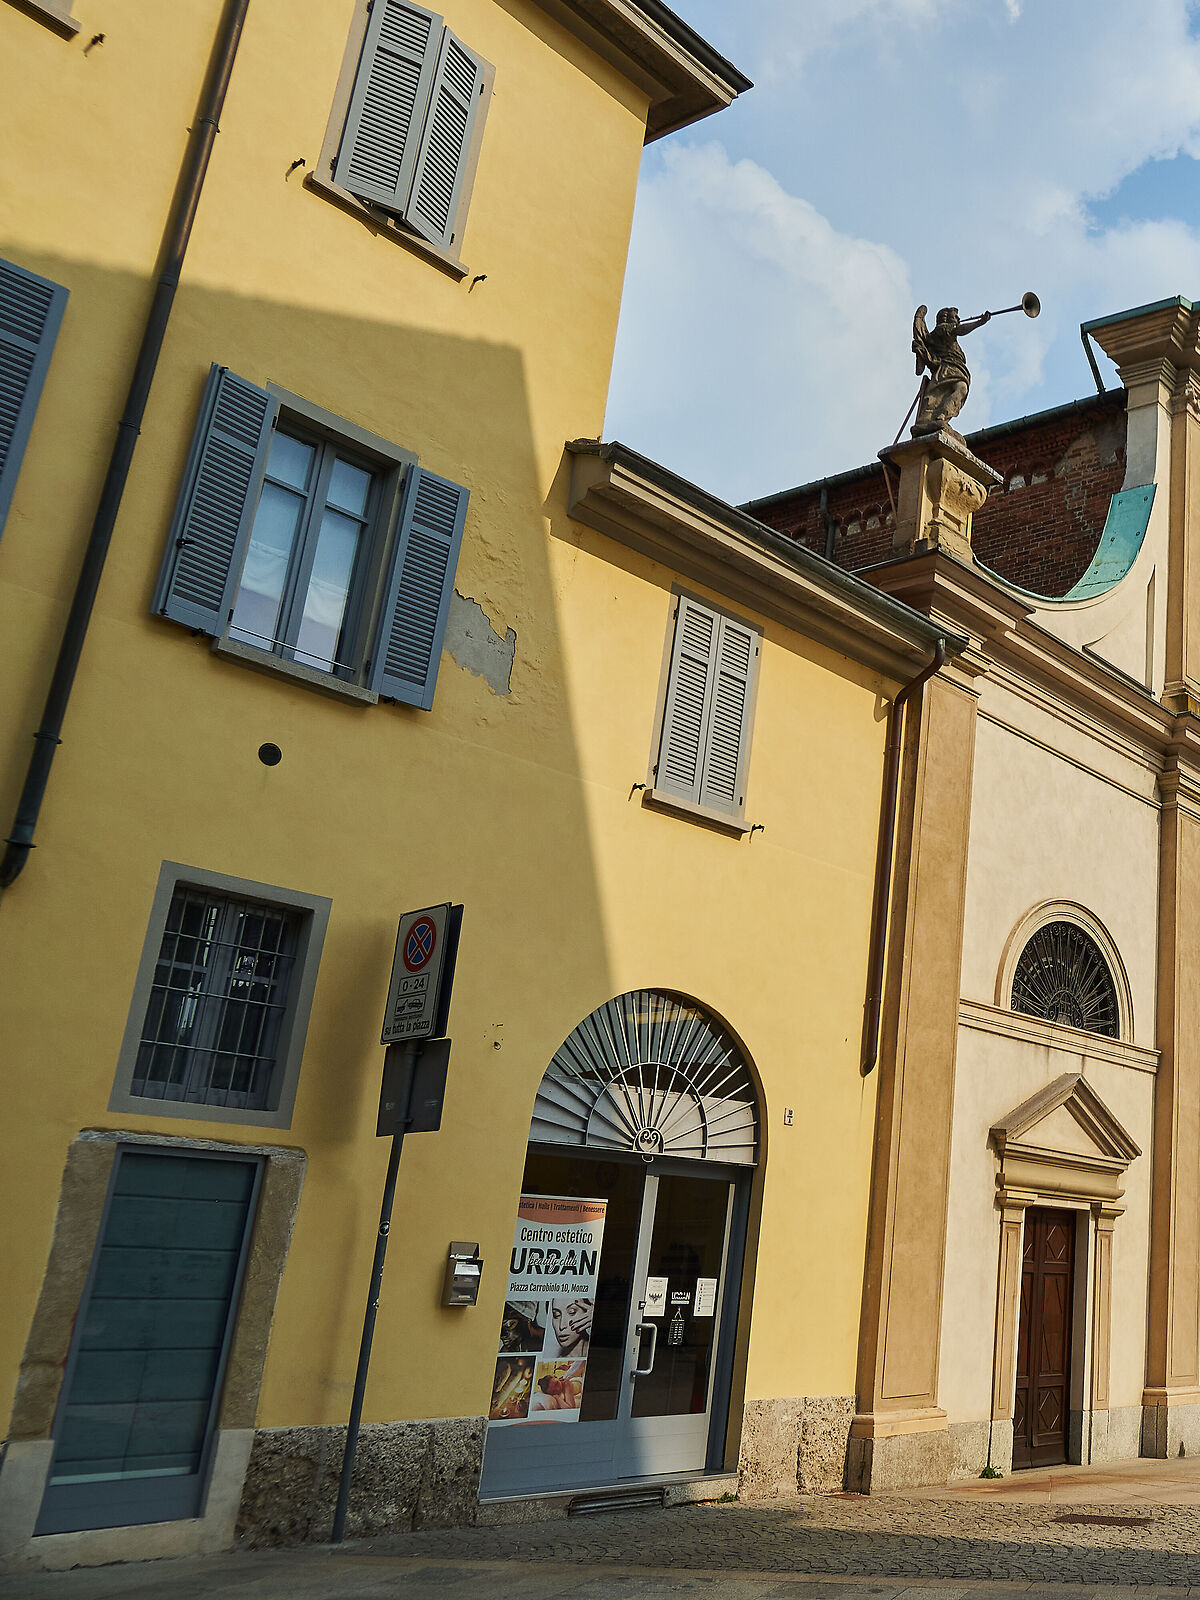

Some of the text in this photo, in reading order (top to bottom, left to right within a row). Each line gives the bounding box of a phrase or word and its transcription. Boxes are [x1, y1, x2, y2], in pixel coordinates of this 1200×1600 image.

[384, 1019, 430, 1036] su tutta la piazza
[519, 1201, 535, 1209] stetica
[583, 1205, 605, 1214] Benessere
[520, 1227, 593, 1244] Centro estetico
[509, 1247, 598, 1276] URBAN
[510, 1281, 529, 1292] Piazza
[529, 1282, 560, 1293] Carrobiolo
[571, 1284, 589, 1293] Monza
